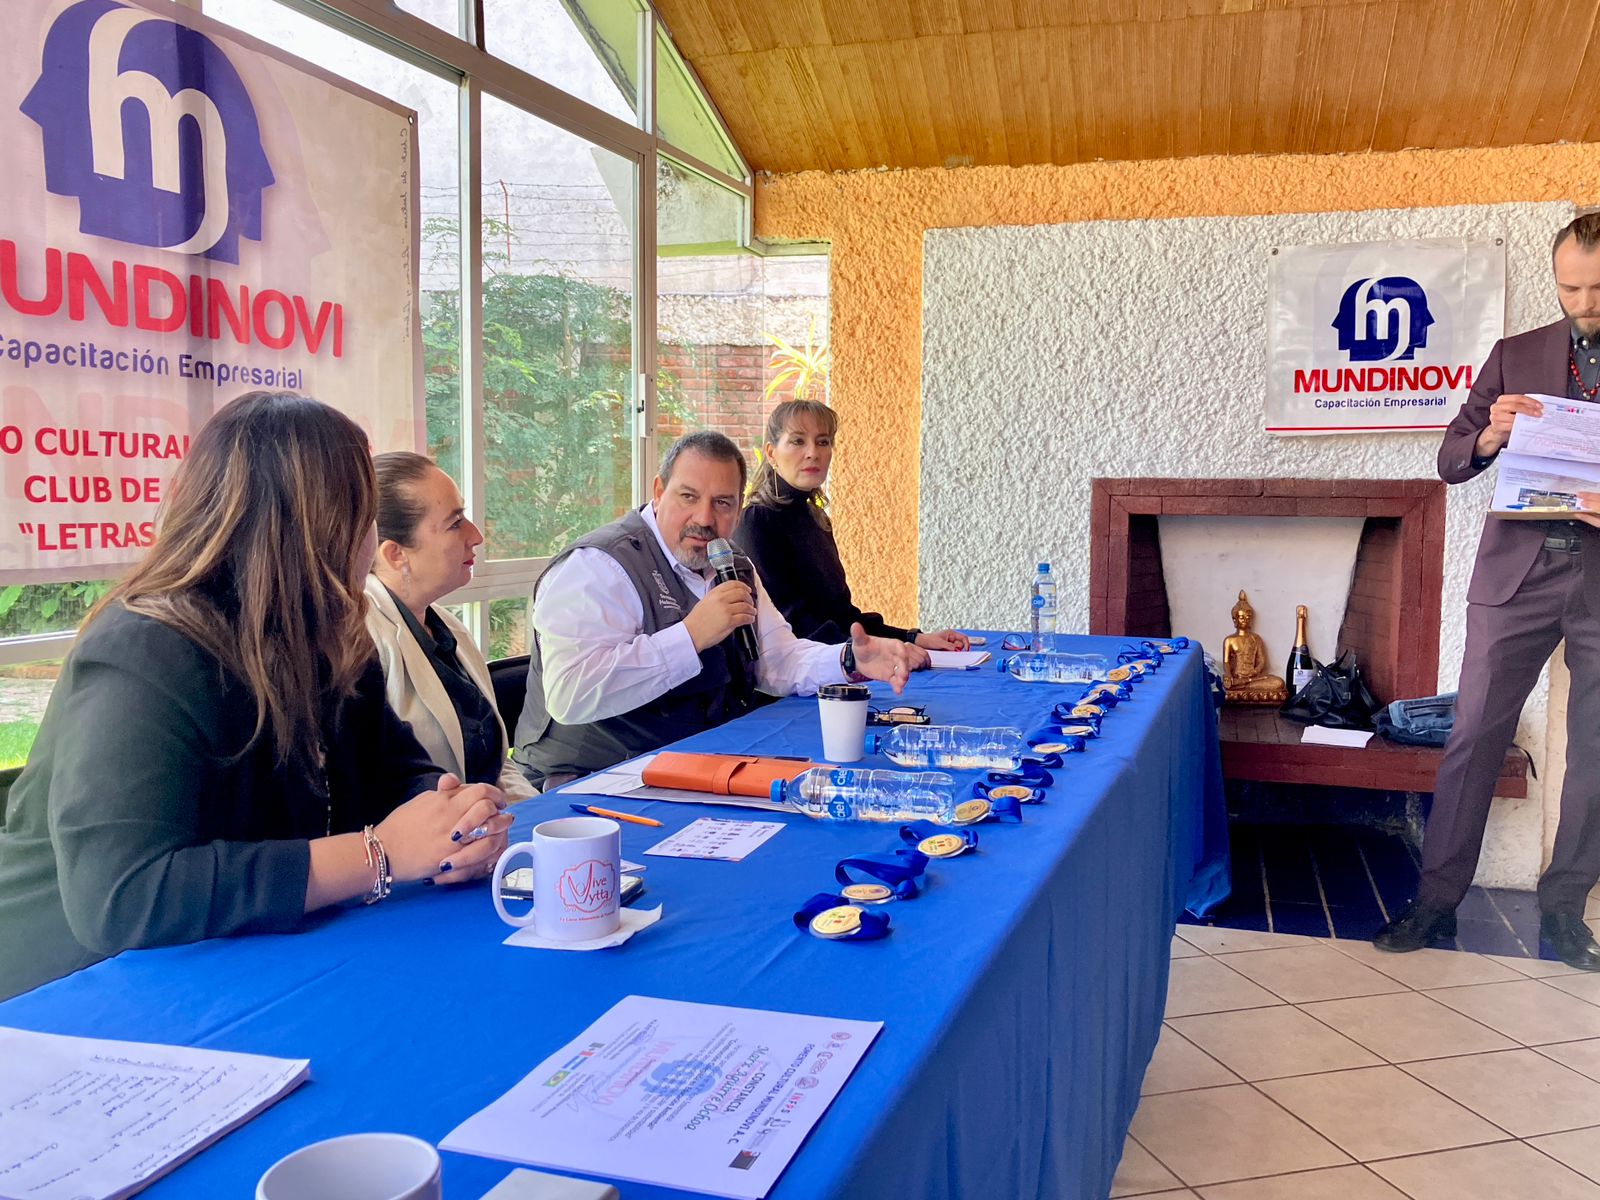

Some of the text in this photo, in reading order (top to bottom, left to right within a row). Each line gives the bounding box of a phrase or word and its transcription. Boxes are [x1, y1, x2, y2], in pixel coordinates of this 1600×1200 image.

[179, 353, 303, 390] Empresarial
[1294, 365, 1472, 393] MUNDINOVI
[1314, 397, 1447, 409] Capacitación Empresarial
[24, 474, 112, 503] CLUB
[120, 477, 161, 503] DE
[18, 522, 156, 551] "LETRAS
[724, 1072, 766, 1113] CONSTANCIA
[684, 1103, 719, 1131] Ochoa
